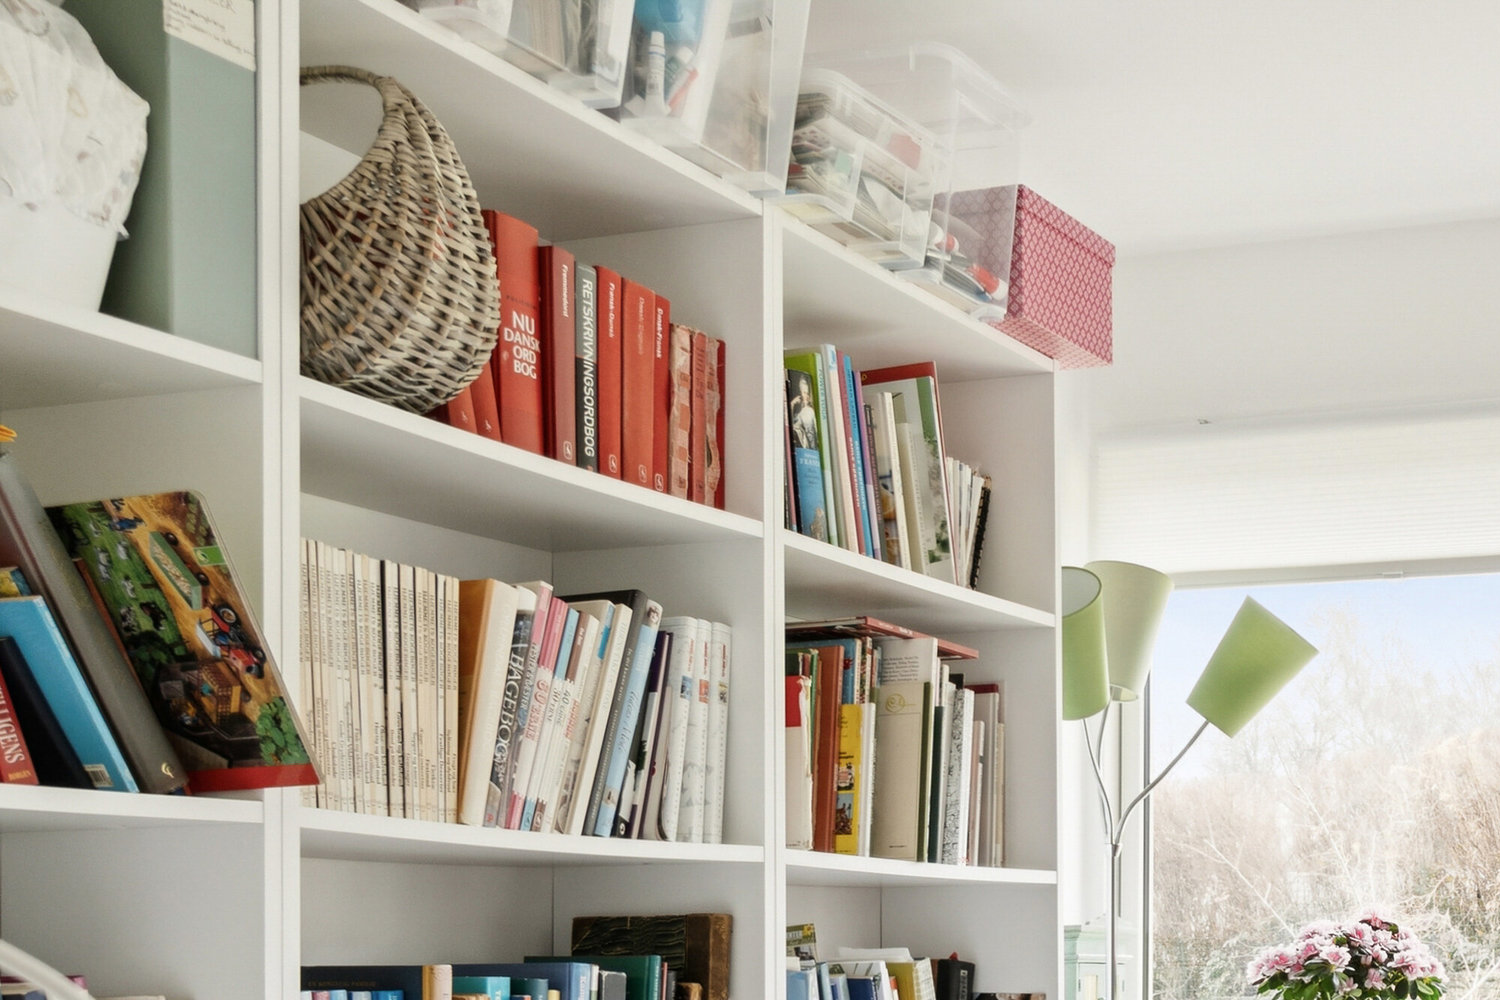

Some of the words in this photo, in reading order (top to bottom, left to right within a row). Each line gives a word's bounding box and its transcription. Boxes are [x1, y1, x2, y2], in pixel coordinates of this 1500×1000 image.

[511, 310, 535, 335] NU
[503, 327, 541, 352] DANSK
[512, 345, 537, 365] ORD
[582, 277, 595, 457] RETSKRIVNINGSORDBOG
[512, 360, 538, 379] BOG
